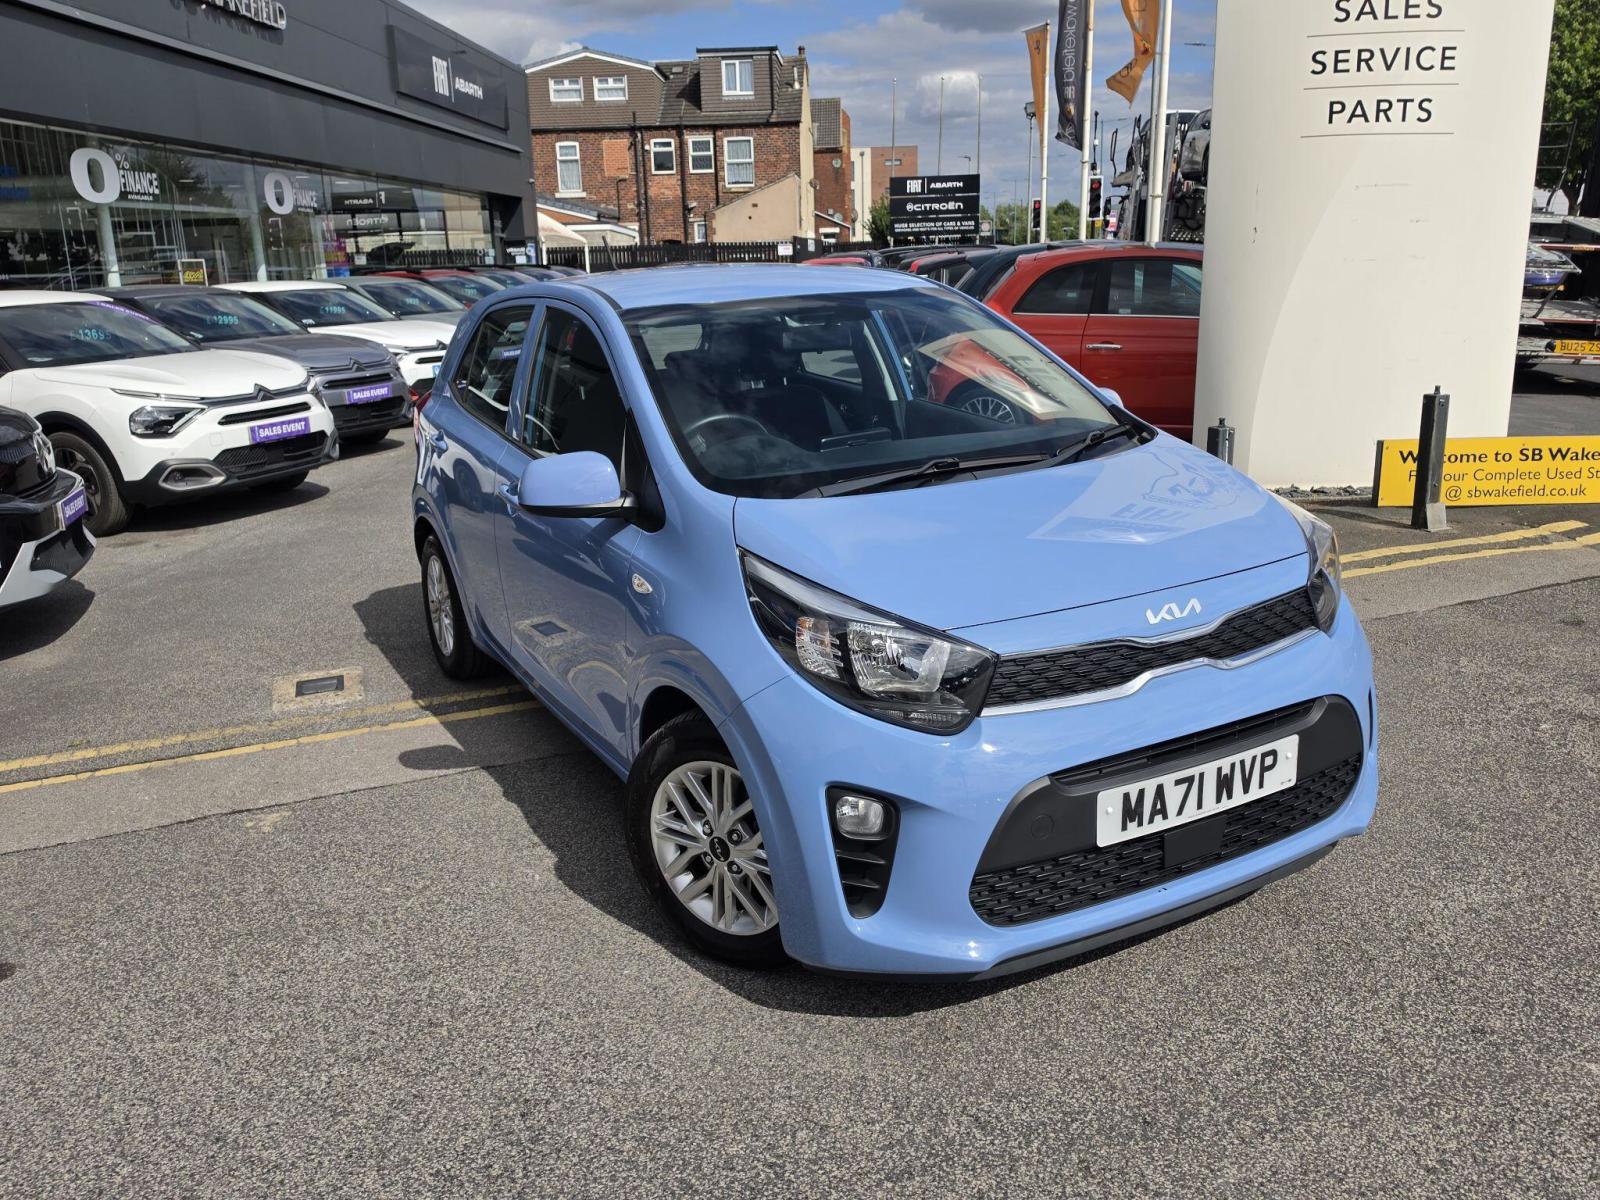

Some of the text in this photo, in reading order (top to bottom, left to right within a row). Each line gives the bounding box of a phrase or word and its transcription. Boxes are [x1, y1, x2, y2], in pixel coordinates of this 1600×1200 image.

[1334, 0, 1443, 23] SALES
[1310, 46, 1457, 75] SERVICE
[455, 76, 484, 100] ABARTH
[1328, 98, 1433, 124] PARTS
[120, 170, 160, 195] FINANCE
[906, 180, 963, 193] FIAT ABARTH
[1560, 341, 1586, 352] BU25
[353, 387, 388, 399] SALES EVENT
[258, 421, 306, 437] SALES EVENT
[1399, 450, 1488, 464] Wome
[1494, 450, 1513, 463] to
[1519, 447, 1543, 462] SB
[1473, 468, 1541, 485] Complete
[1546, 467, 1583, 480] Used
[1445, 484, 1587, 502] @ sbwakefield.co.uk
[1146, 598, 1202, 625] KIA
[1121, 748, 1278, 832] MA71 WVP
